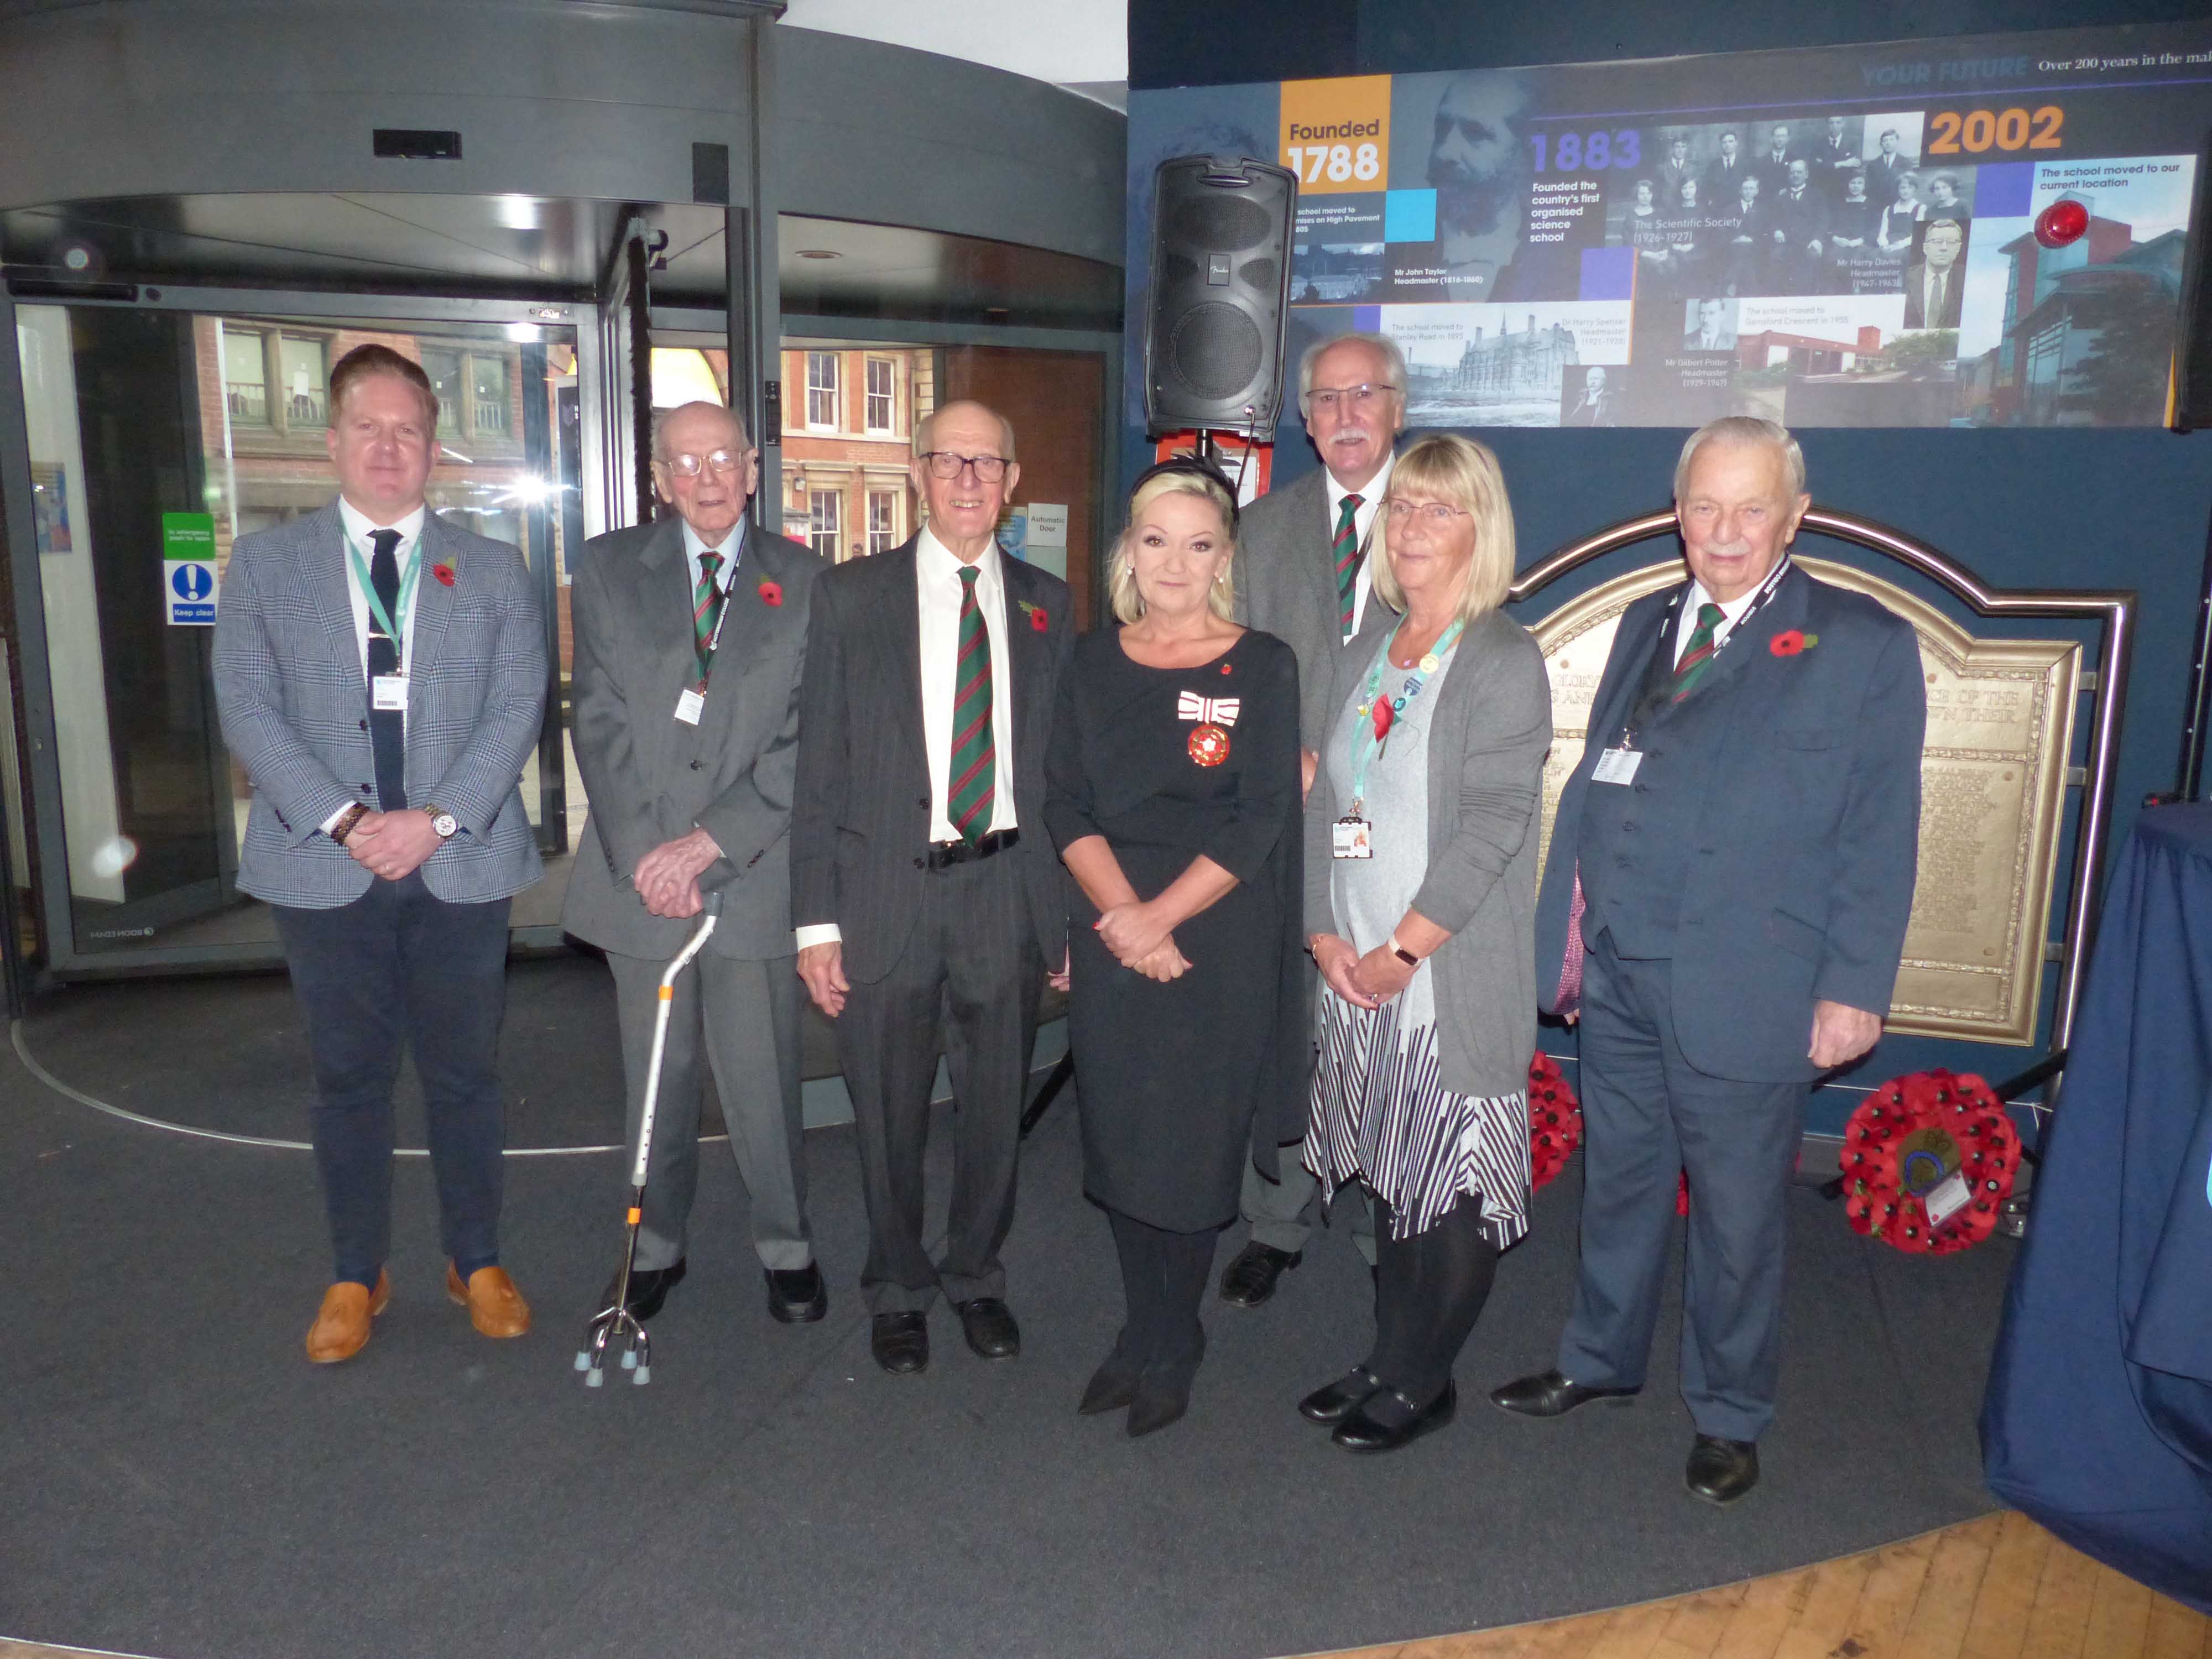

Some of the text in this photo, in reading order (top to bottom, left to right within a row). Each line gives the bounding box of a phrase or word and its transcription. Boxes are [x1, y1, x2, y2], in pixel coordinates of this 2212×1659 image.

[2038, 60, 2072, 71] Over
[2074, 58, 2098, 70] 200
[2100, 58, 2138, 71] years
[2142, 54, 2155, 66] in
[2160, 53, 2182, 64] the
[1860, 56, 2027, 86] YOUR FUTURE
[1290, 119, 1380, 140] Founded
[1928, 106, 2064, 154] 2002
[1530, 129, 1641, 173] 1883
[1287, 143, 1380, 183] 1788
[2042, 164, 2180, 177] The school moved to our
[1532, 181, 1597, 192] Founded the
[2040, 179, 2128, 190] current location
[1532, 194, 1599, 205] country's first
[1297, 207, 1321, 216] school
[1531, 207, 1583, 219] organised
[1530, 220, 1571, 229] science
[1636, 218, 1741, 229] The Scientific Society
[1530, 232, 1564, 242] school
[1850, 259, 1872, 267] Harry
[1762, 307, 1787, 315] school
[1406, 323, 1430, 331] school
[1031, 515, 1065, 524] Automatic
